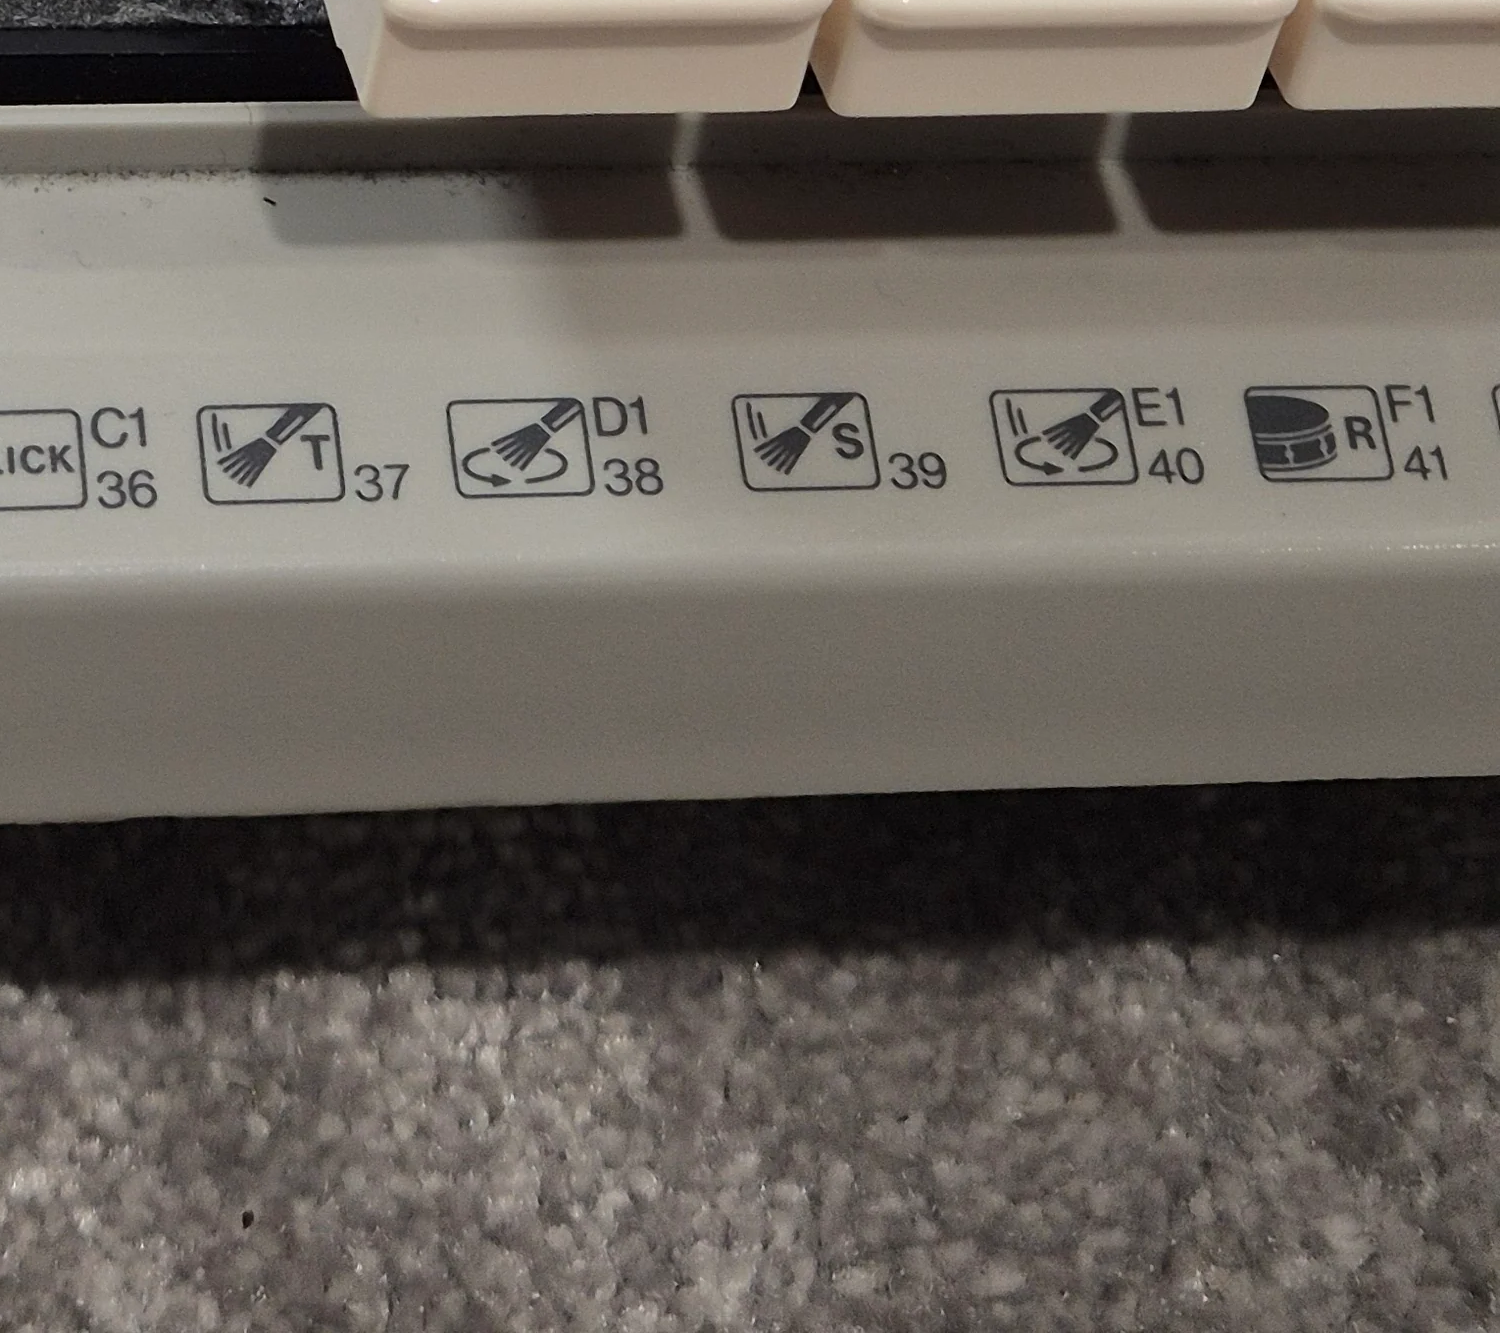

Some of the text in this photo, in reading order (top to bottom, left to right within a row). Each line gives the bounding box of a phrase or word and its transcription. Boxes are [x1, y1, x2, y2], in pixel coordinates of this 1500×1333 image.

[593, 395, 649, 438] D1
[1131, 386, 1185, 429] E1
[1385, 384, 1434, 424] F1
[90, 406, 148, 449] C1
[830, 423, 866, 461] S
[1344, 415, 1376, 451] R
[300, 434, 332, 471] T
[887, 451, 948, 491] 39
[1147, 446, 1205, 487] 40
[1402, 443, 1450, 482] 41
[96, 469, 158, 510] 36
[352, 463, 411, 503] 37
[603, 457, 665, 497] 38
